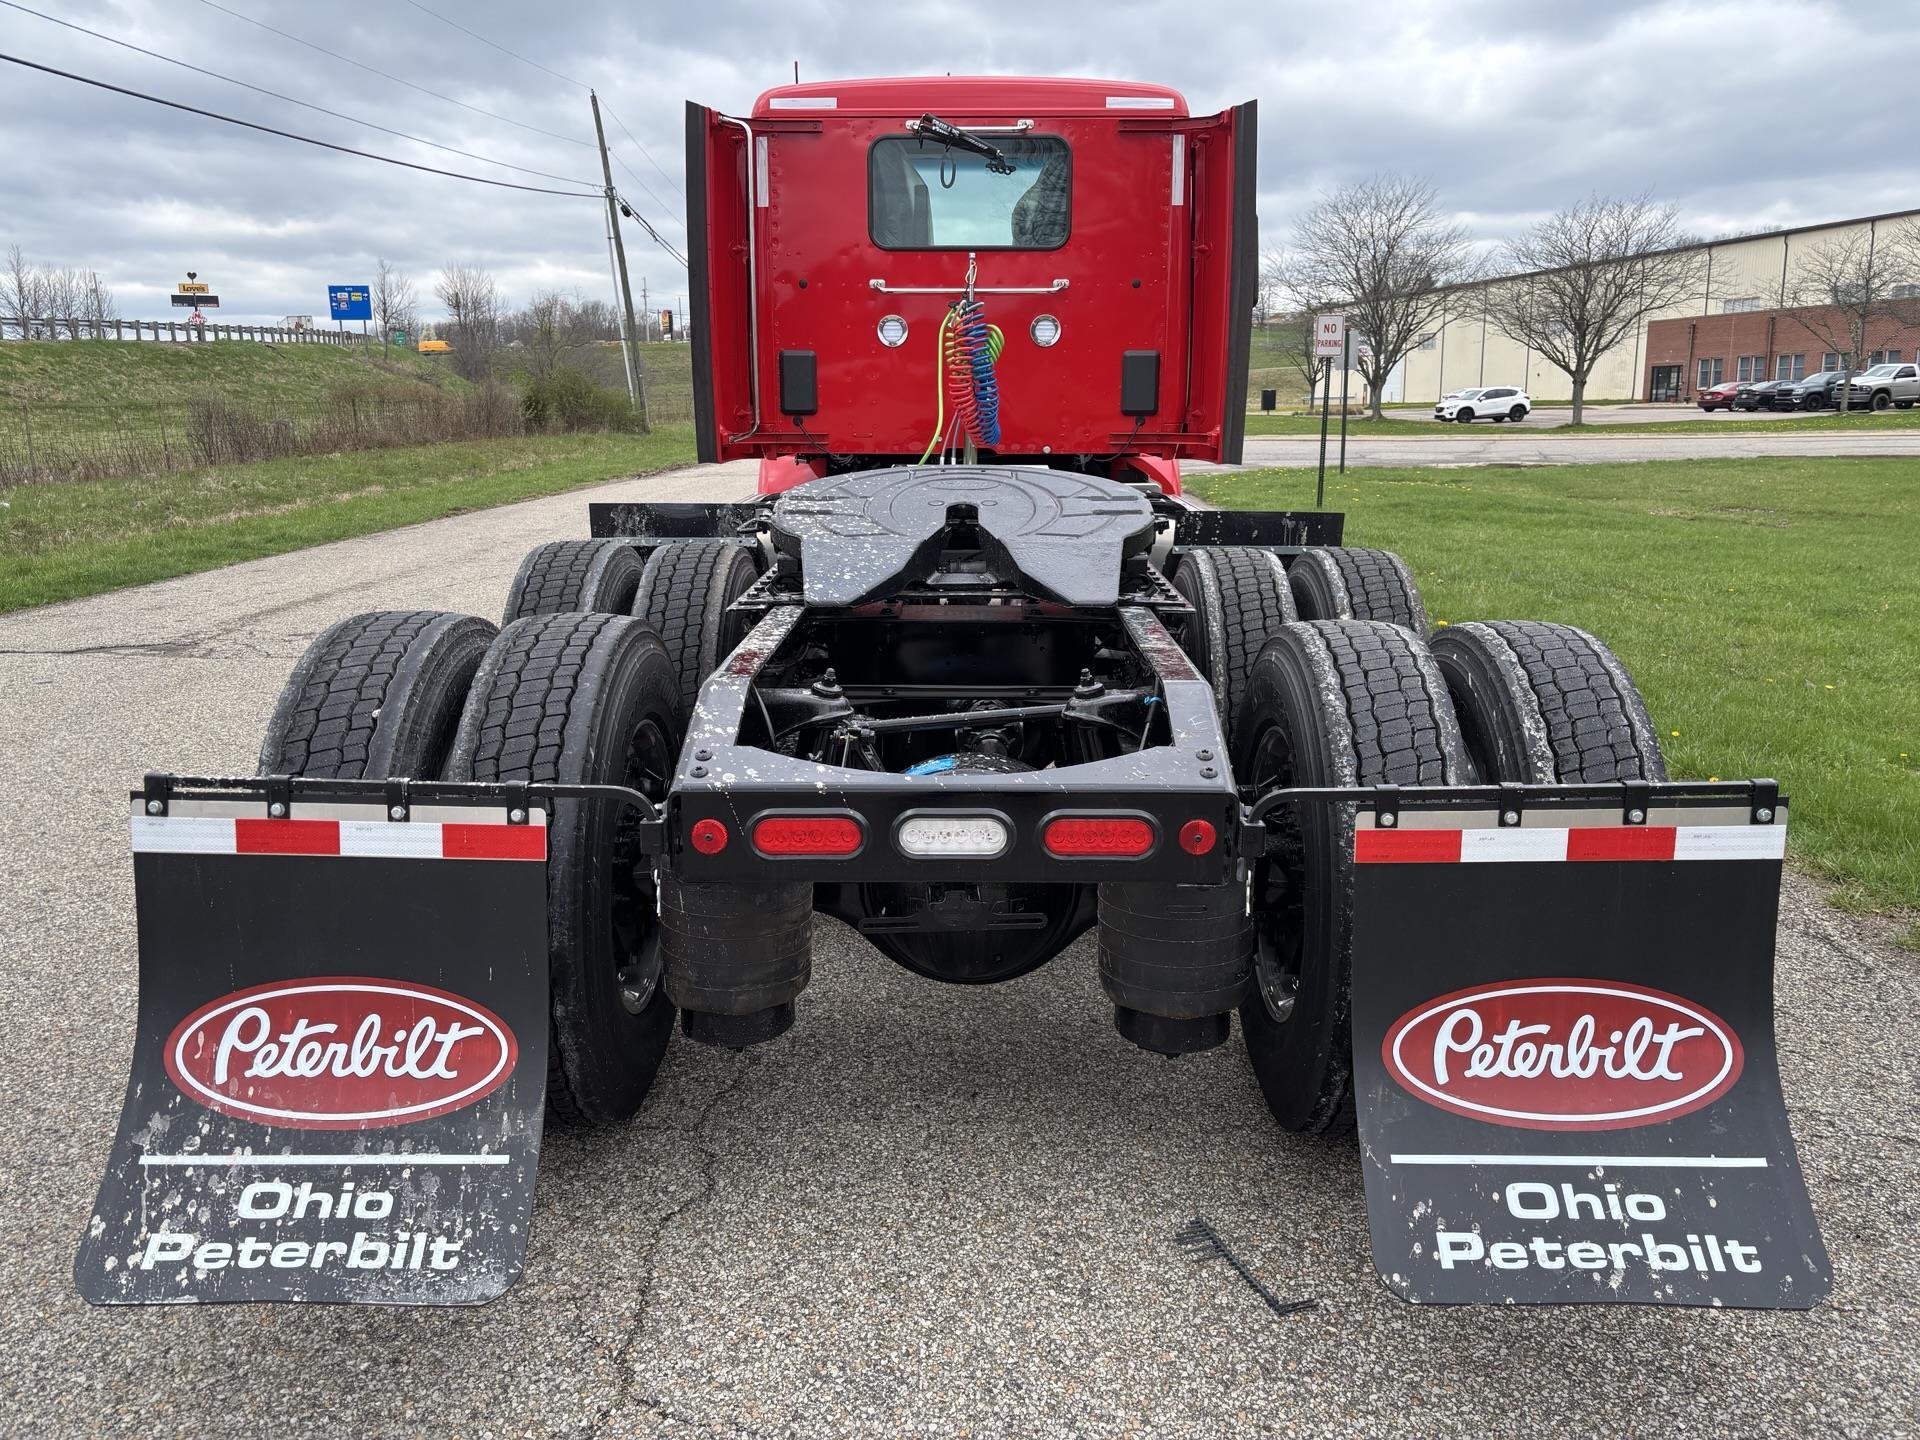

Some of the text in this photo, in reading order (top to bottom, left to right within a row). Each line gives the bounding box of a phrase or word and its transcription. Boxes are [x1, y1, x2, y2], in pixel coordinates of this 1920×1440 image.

[1317, 340, 1343, 348] PARKING
[1324, 323, 1337, 334] NO
[215, 1007, 484, 1085] Peterbilt
[1433, 1008, 1704, 1085] Peterbilt
[238, 1182, 394, 1219] Ohio
[1505, 1182, 1667, 1221] Ohio
[140, 1231, 462, 1270] Peterbilt
[1436, 1232, 1762, 1273] Peterbilt
